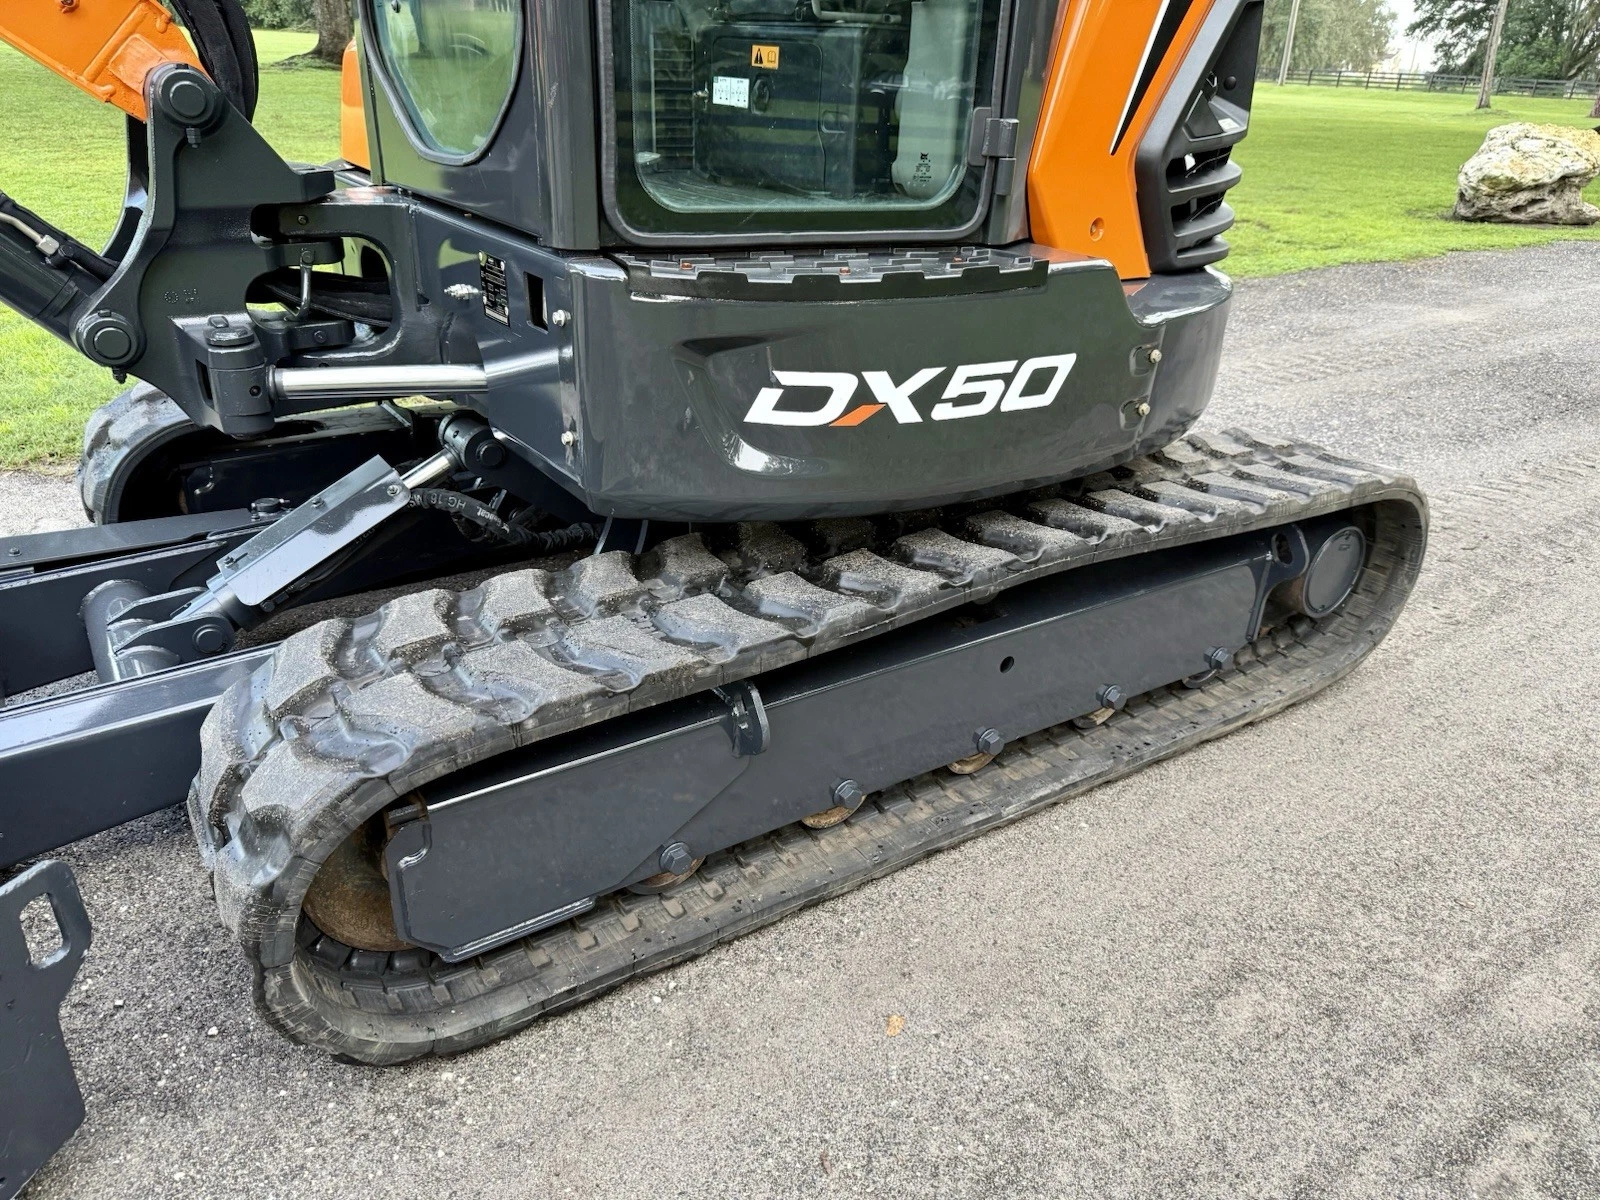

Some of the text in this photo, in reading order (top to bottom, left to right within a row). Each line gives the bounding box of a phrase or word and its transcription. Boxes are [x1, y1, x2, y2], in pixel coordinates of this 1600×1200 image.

[743, 352, 1077, 427] DX50
[430, 492, 443, 504] 16
[447, 496, 467, 509] HG
